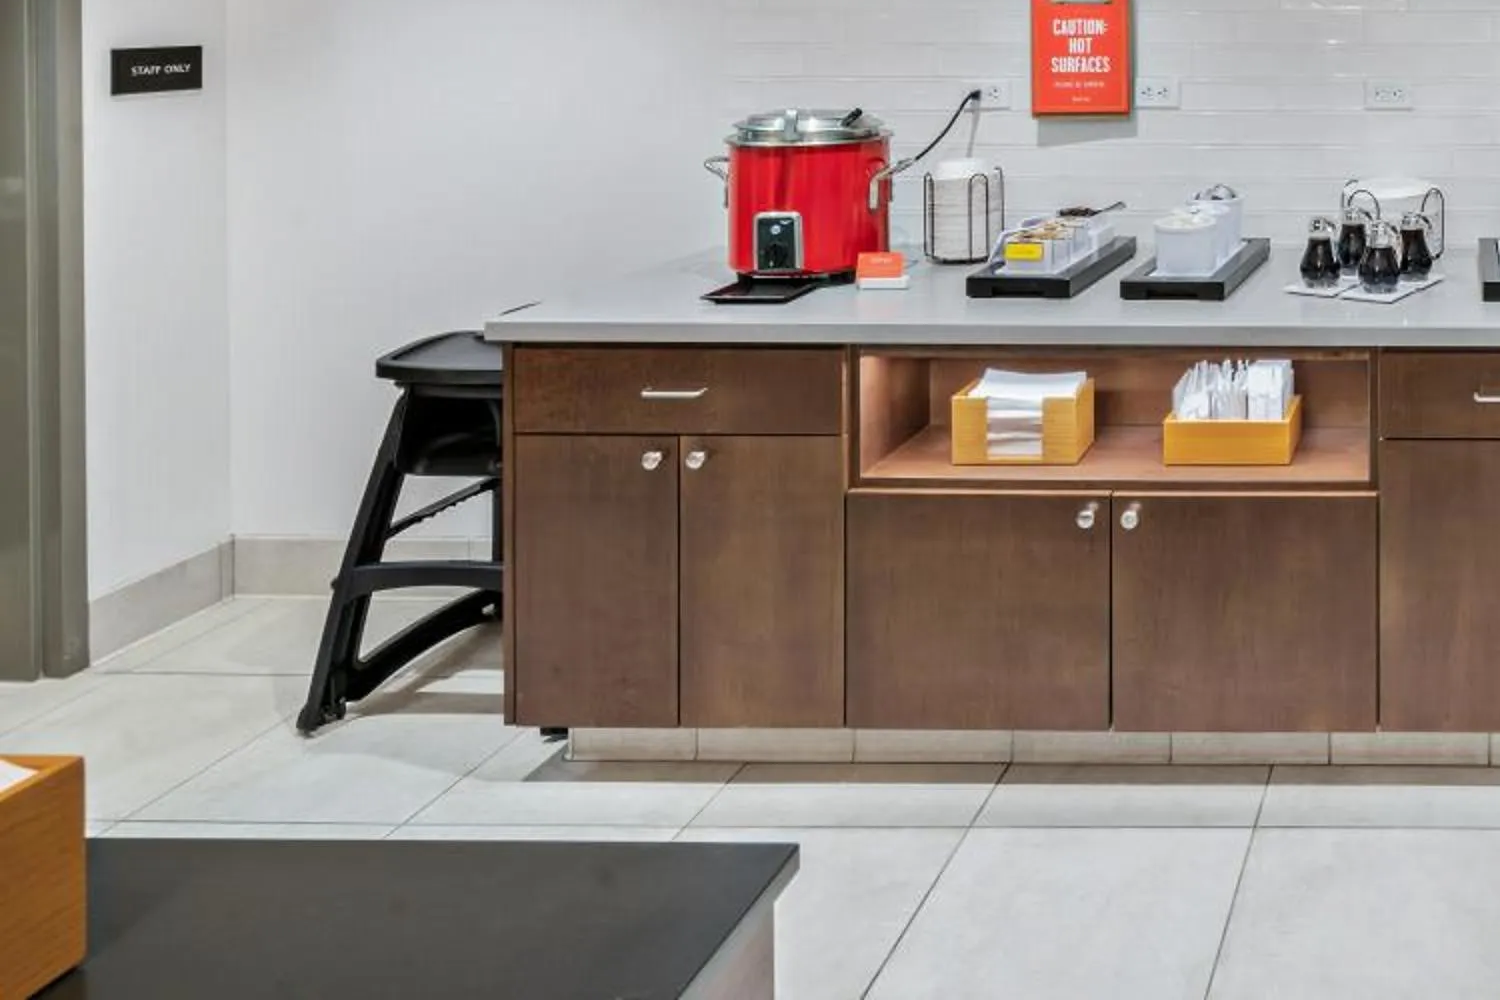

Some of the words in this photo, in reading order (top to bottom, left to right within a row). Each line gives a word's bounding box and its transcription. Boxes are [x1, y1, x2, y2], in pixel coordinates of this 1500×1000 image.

[1052, 18, 1108, 36] CAUTION:
[1068, 37, 1093, 54] HOT
[131, 64, 161, 76] STAFF
[164, 63, 191, 74] ONLY
[1051, 56, 1111, 73] SURFACES
